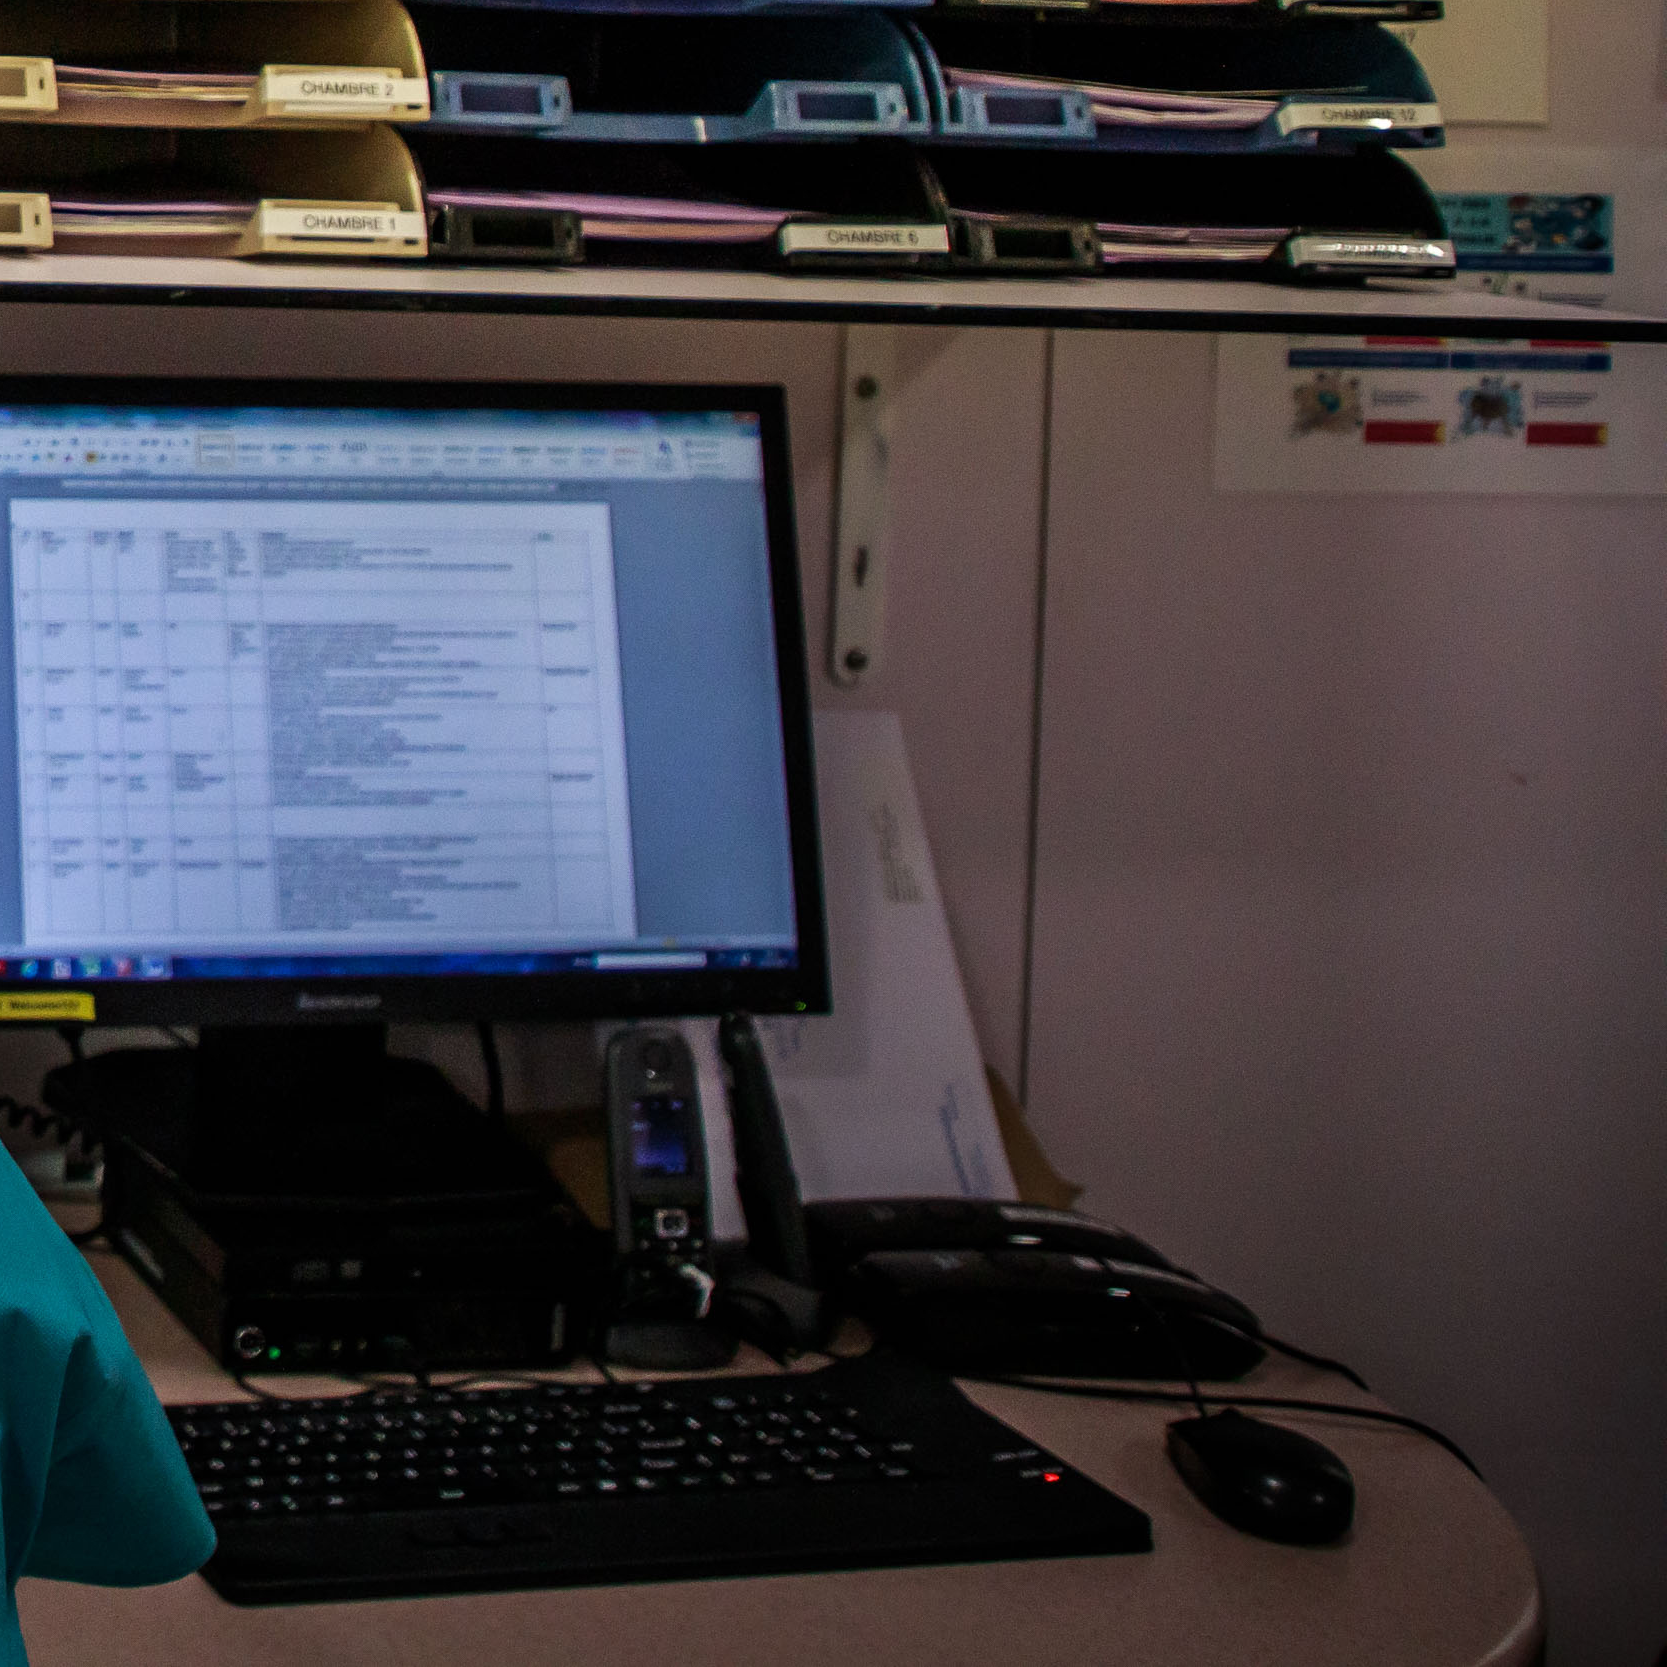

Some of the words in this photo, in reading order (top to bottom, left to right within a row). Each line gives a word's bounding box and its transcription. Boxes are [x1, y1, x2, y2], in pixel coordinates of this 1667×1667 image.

[301, 80, 378, 97] CHAMBRE
[385, 83, 395, 97] 2
[303, 214, 379, 230] CHAMBRE
[388, 217, 396, 230] 1
[827, 229, 900, 246] CHAMBRE
